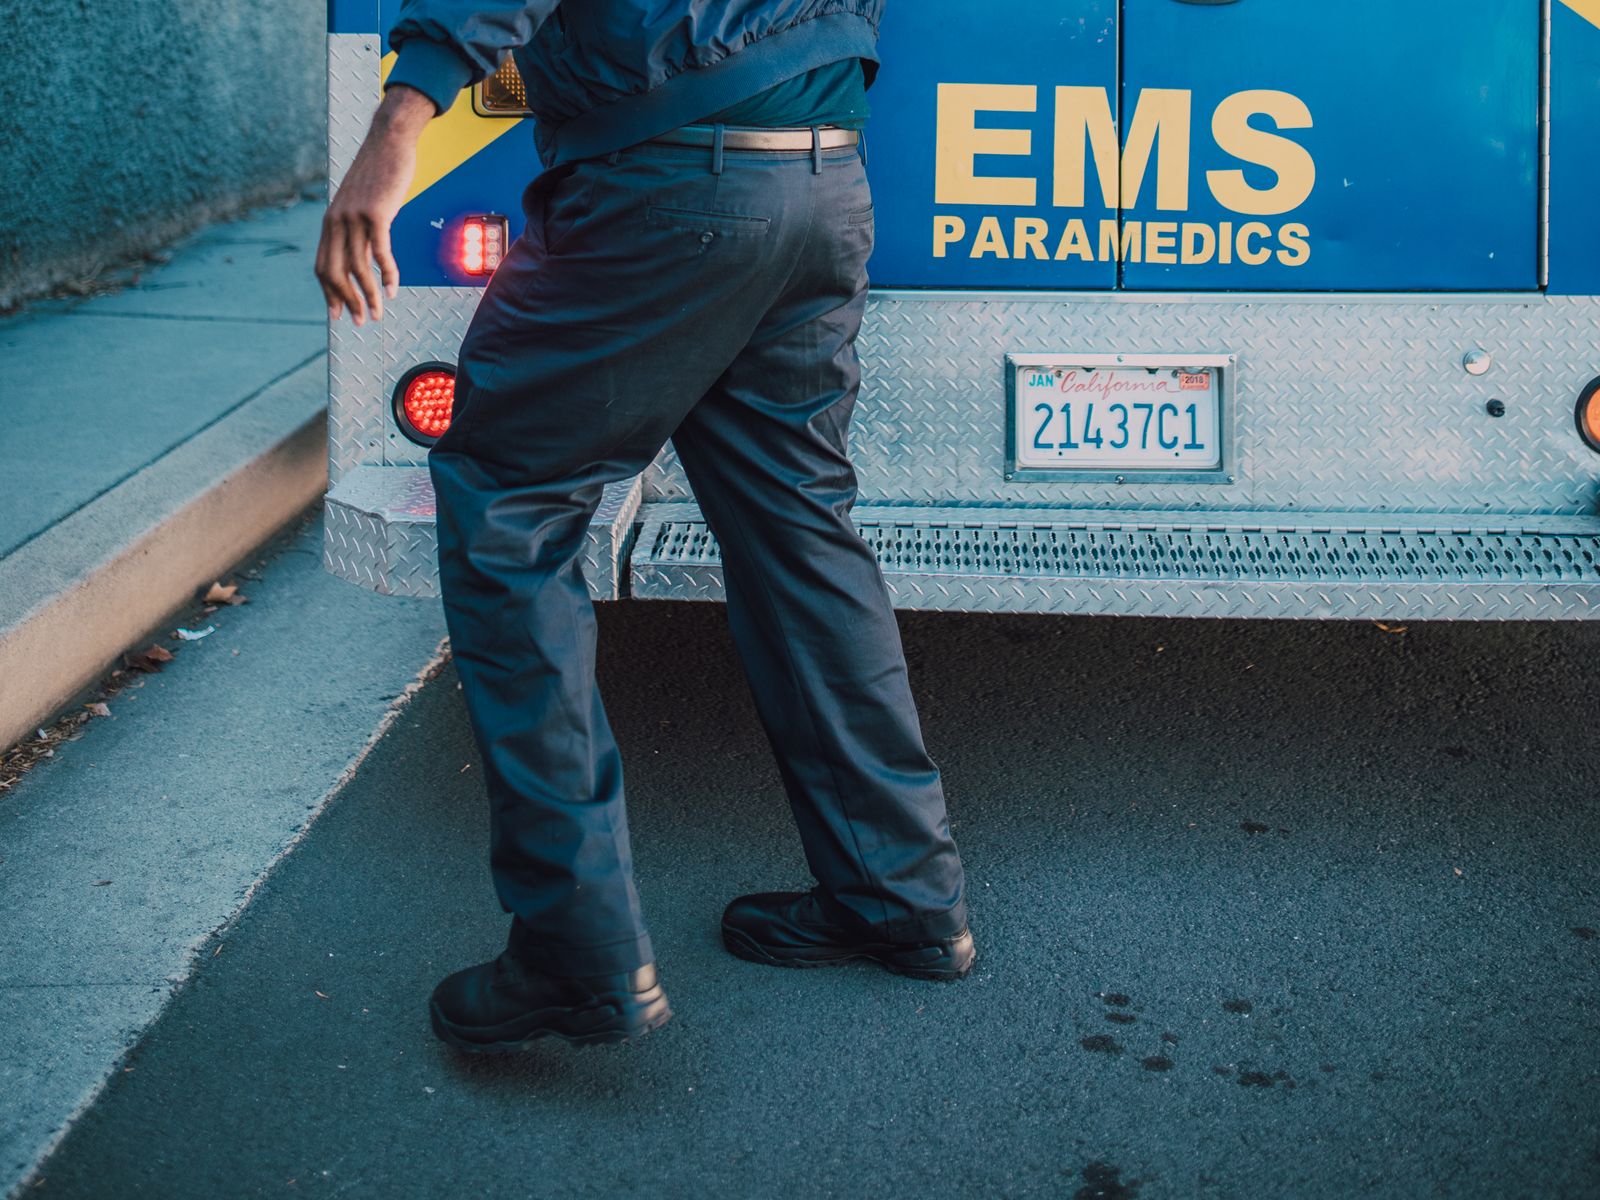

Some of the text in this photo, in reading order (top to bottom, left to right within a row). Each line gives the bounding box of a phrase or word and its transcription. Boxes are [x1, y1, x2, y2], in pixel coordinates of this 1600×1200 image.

[935, 83, 1315, 215] EMS
[933, 215, 1311, 266] PARAMEDICS
[1028, 373, 1054, 388] JAN
[1060, 370, 1182, 401] California
[1184, 375, 1204, 384] 2018
[1033, 402, 1206, 450] 21437C1
